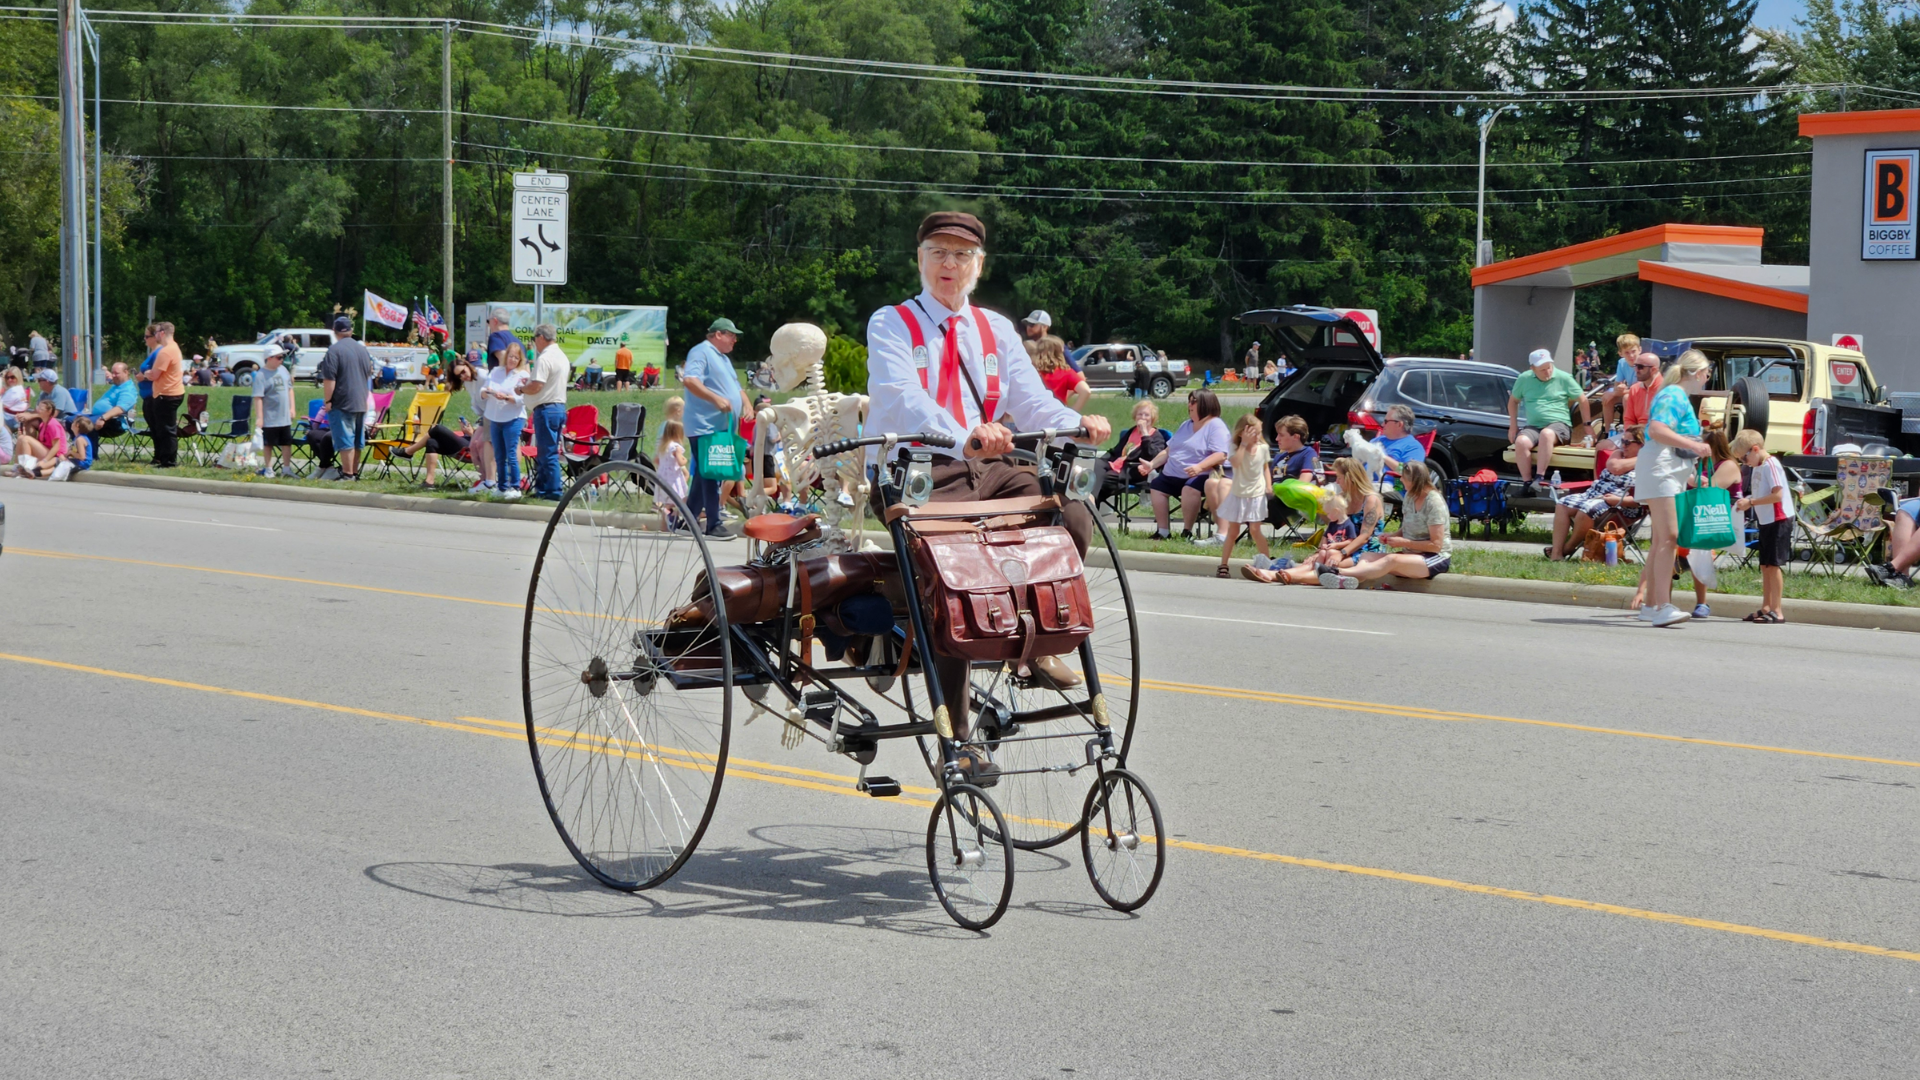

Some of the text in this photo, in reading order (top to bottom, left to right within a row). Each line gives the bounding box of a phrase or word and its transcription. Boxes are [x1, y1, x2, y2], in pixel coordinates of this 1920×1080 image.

[530, 177, 551, 186] END
[1877, 163, 1905, 219] B
[521, 195, 560, 206] CENTER
[527, 207, 554, 217] LANE
[1868, 229, 1911, 241] BIGGBY
[1868, 244, 1911, 255] COFFEE
[526, 268, 553, 278] ONLY
[587, 336, 619, 346] DAVEY
[1836, 367, 1854, 376] ENTER
[1692, 503, 1729, 516] O'Neill
